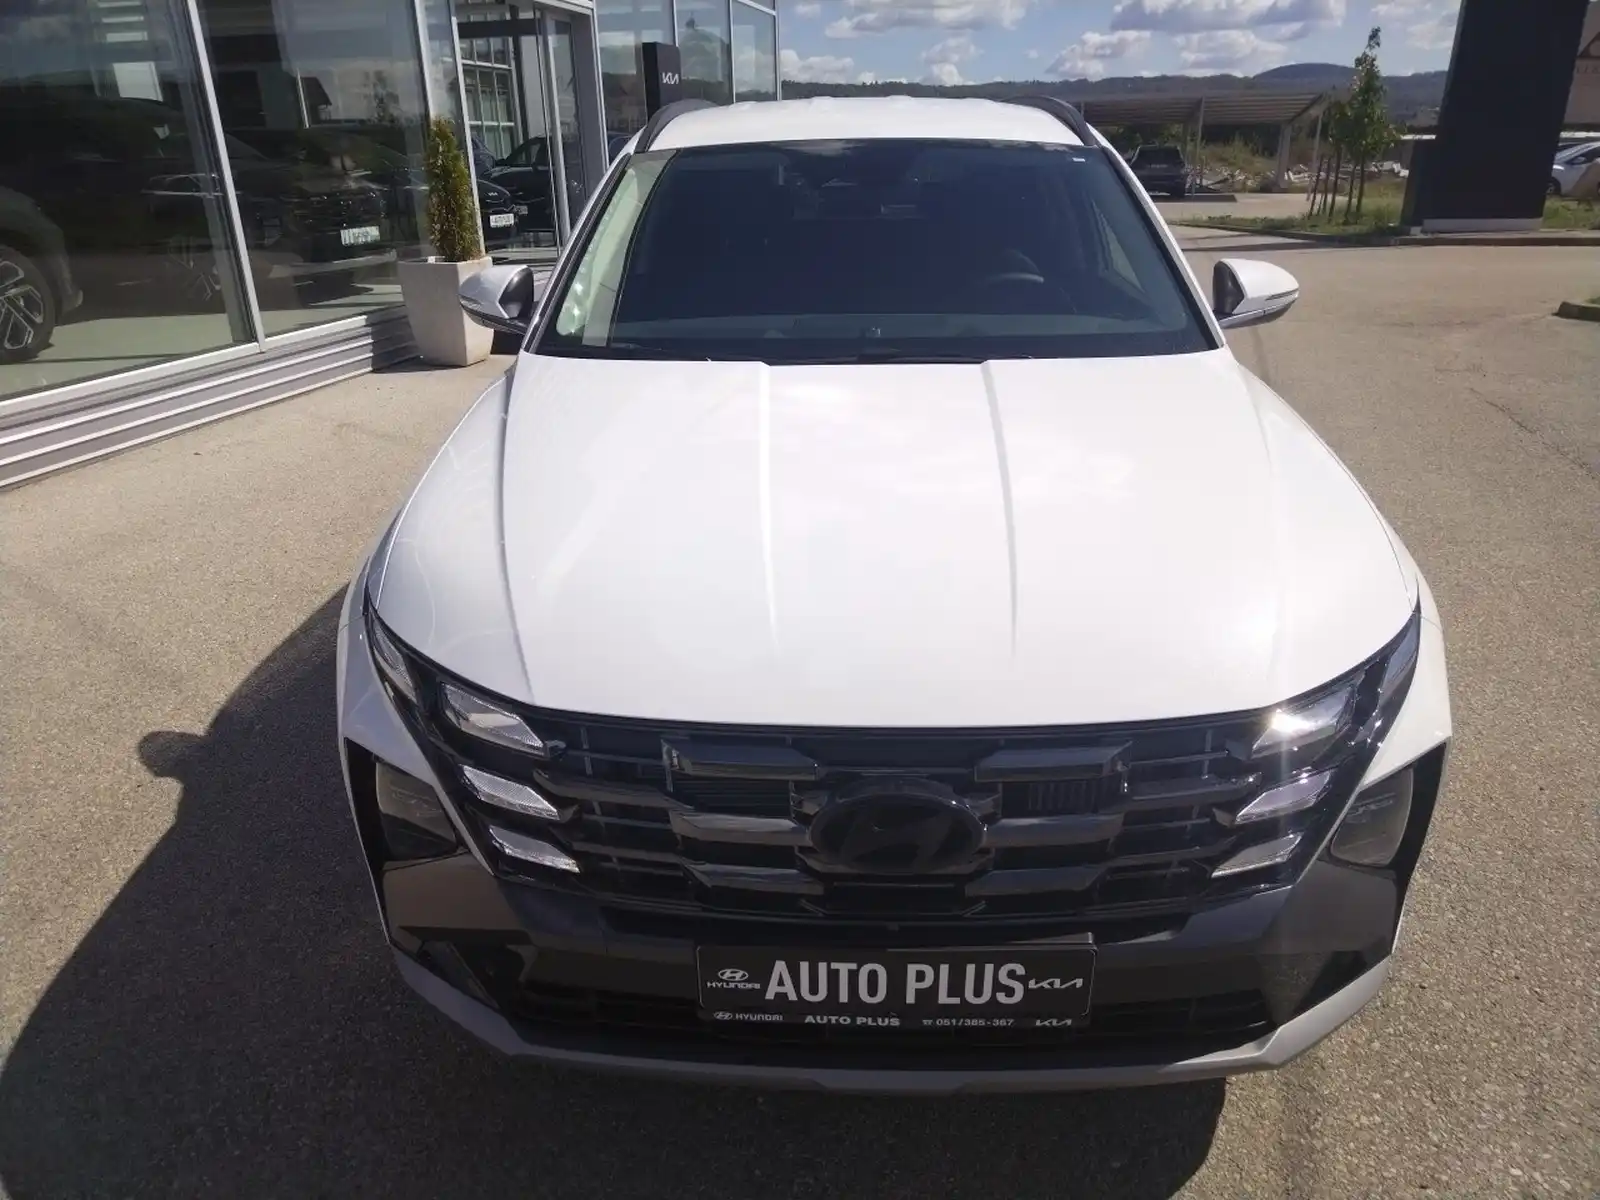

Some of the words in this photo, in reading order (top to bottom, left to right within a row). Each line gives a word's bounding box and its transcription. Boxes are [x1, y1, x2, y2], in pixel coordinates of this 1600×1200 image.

[662, 72, 680, 84] KIA
[706, 981, 761, 989] HYUNDAI
[764, 960, 887, 1003] AUTO
[906, 963, 1026, 1004] PLUS
[1028, 978, 1083, 989] KIA
[735, 1013, 783, 1021] HYUNDAI
[804, 1015, 851, 1024] AUTO
[856, 1016, 901, 1026] PLUS
[1035, 1018, 1072, 1026] KIA
